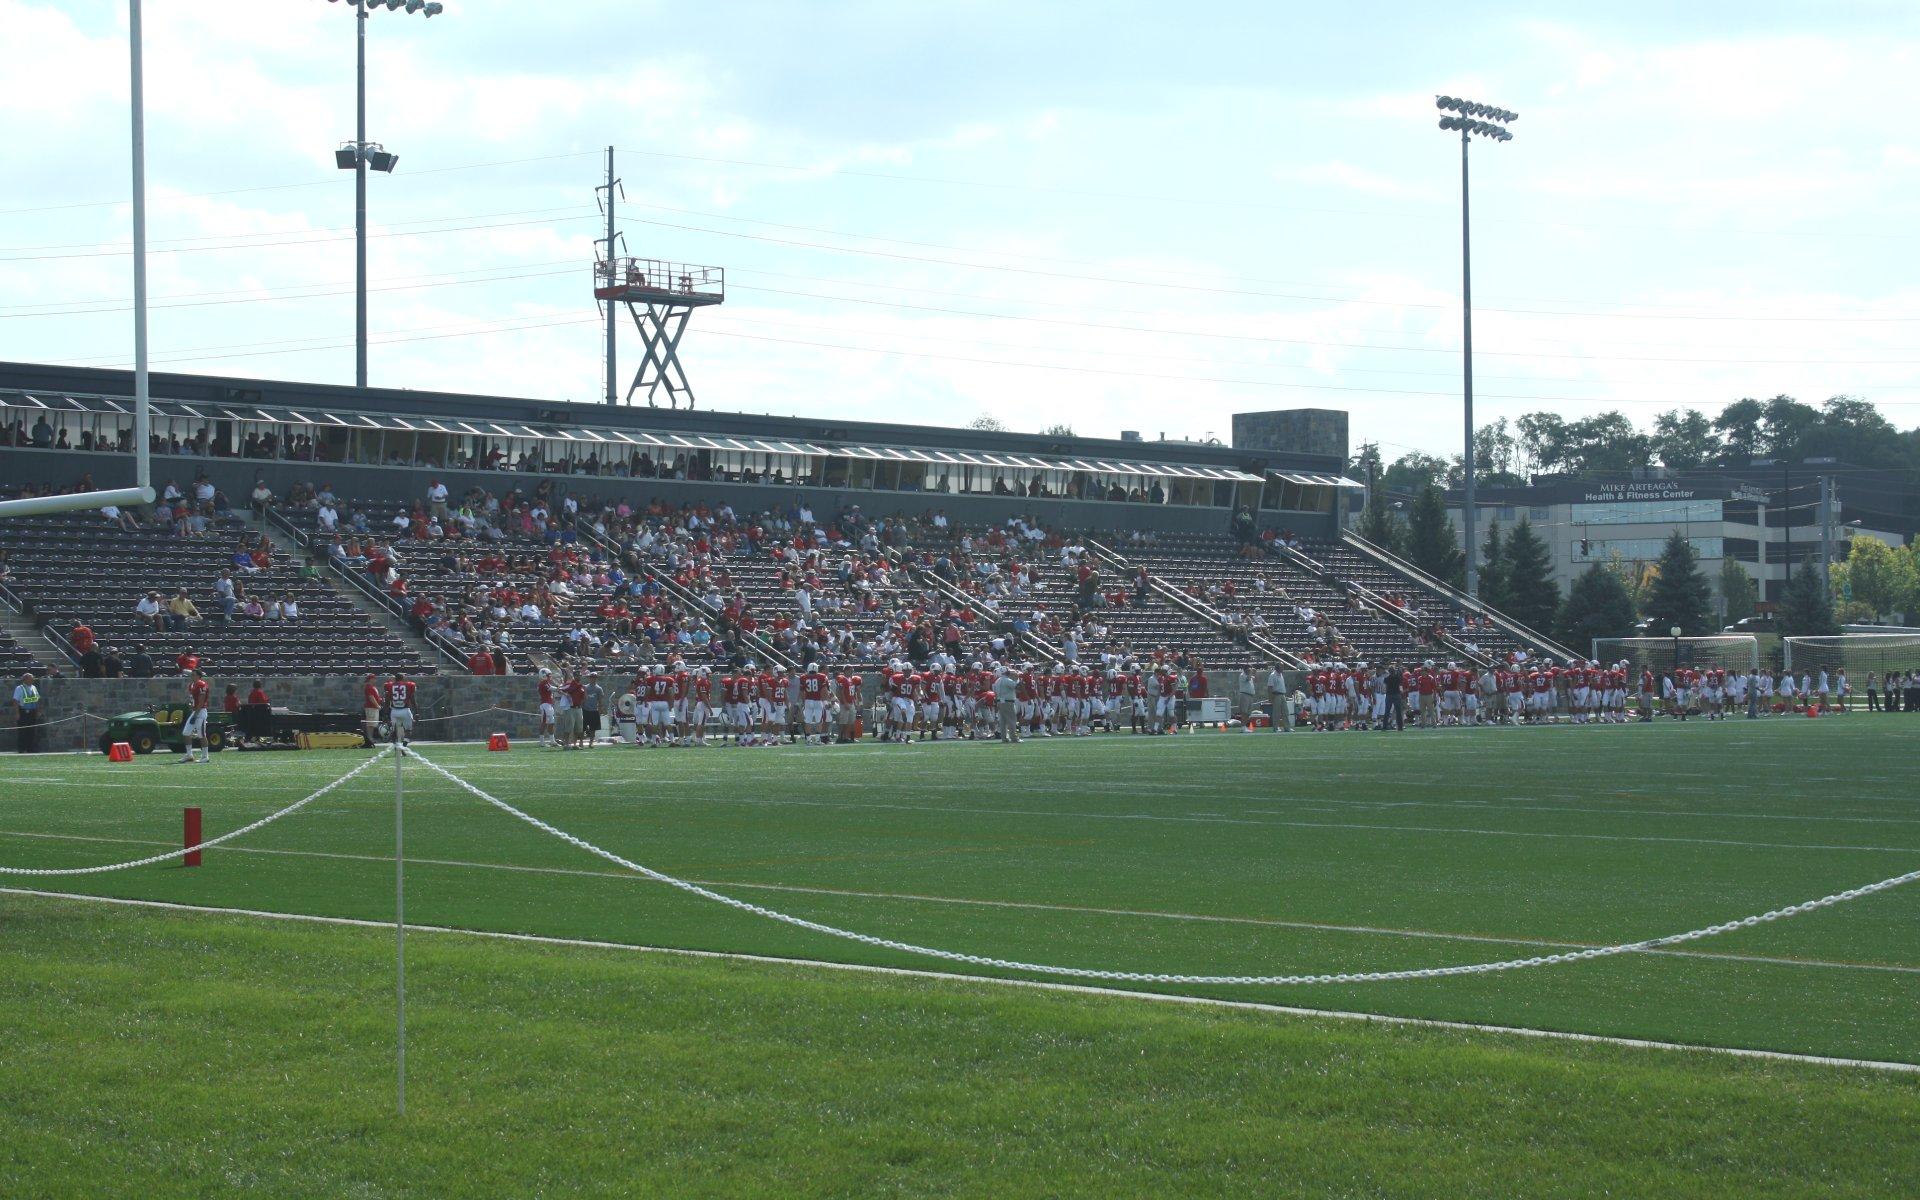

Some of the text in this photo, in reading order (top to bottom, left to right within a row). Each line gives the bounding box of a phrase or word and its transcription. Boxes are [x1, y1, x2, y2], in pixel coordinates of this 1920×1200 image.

[1600, 481, 1678, 492] MIKE ARTEAGA'S
[1585, 489, 1694, 501] Health & Fitness Center
[654, 681, 667, 695] 47
[805, 679, 818, 692] 38
[900, 684, 912, 695] 50
[392, 685, 406, 700] 53
